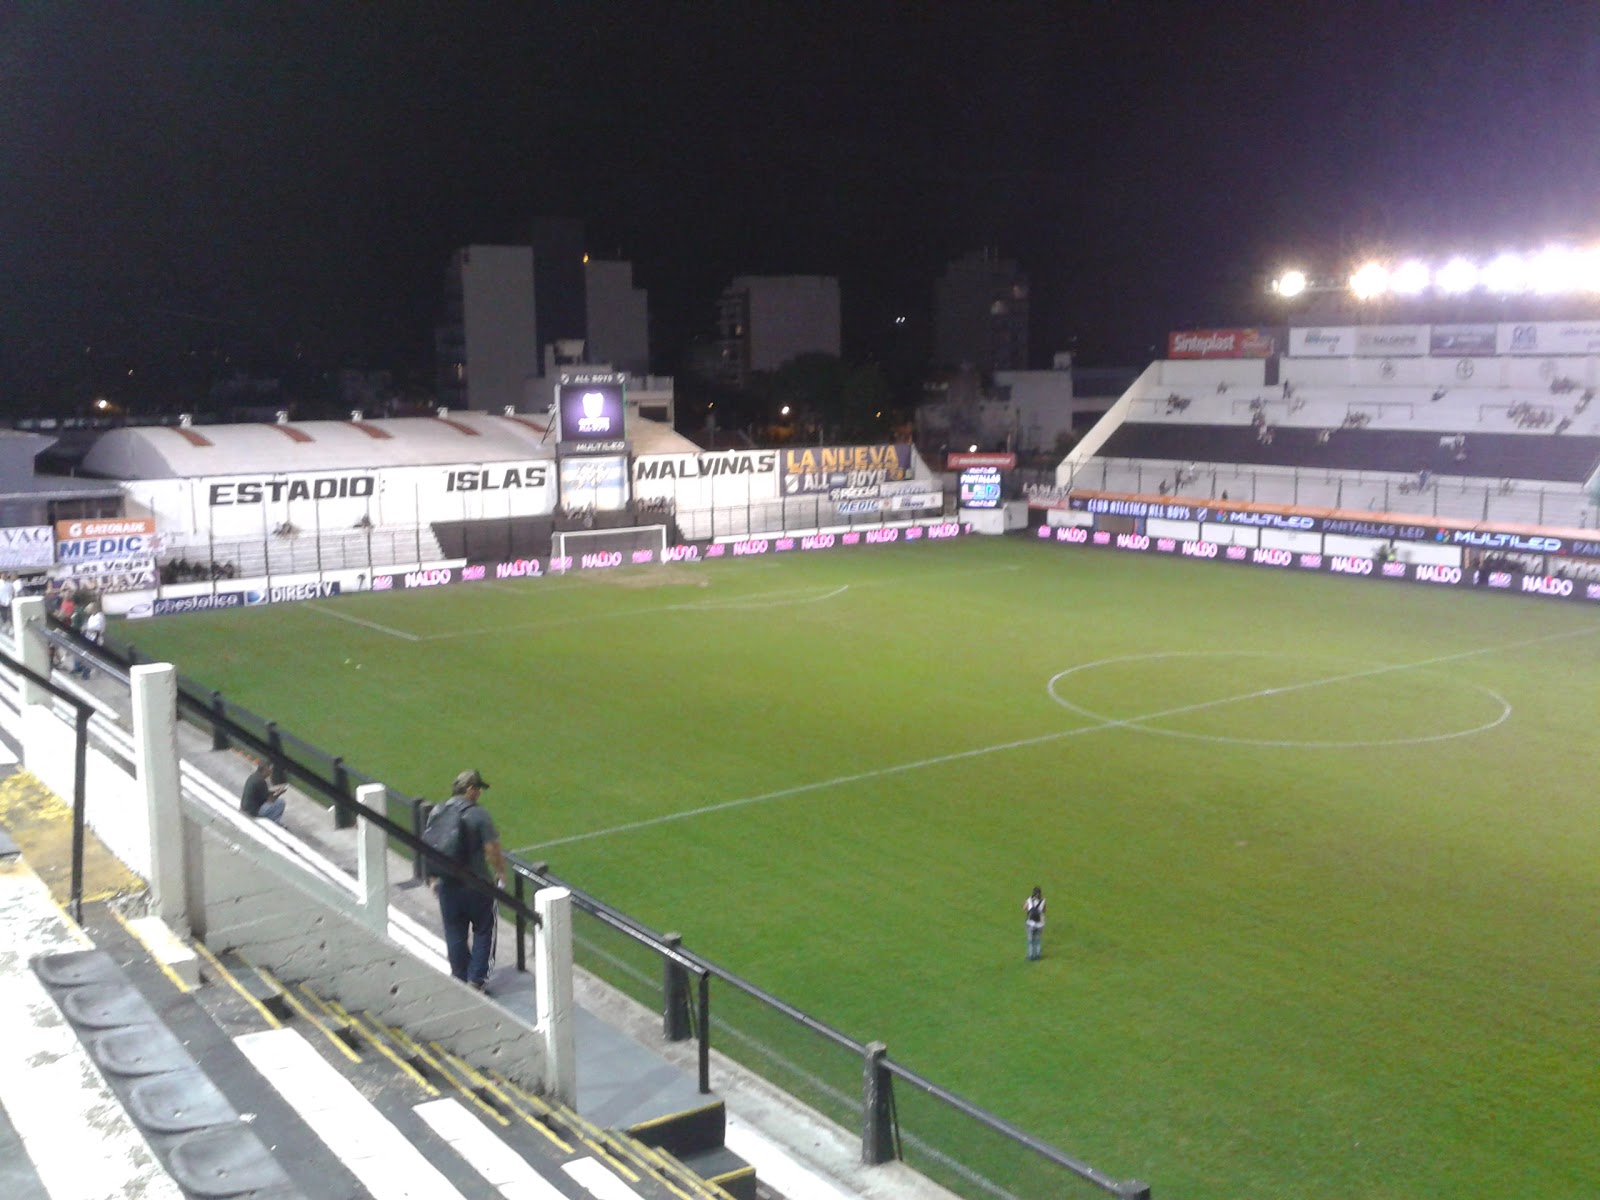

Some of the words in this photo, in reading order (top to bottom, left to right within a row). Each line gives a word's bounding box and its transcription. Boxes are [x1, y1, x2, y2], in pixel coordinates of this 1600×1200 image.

[1174, 333, 1235, 356] Sinteplast
[576, 443, 625, 452] MULTILED
[637, 455, 775, 481] MALVINAS
[787, 449, 819, 473] LA
[821, 445, 899, 472] NUEVA
[446, 467, 547, 492] ISLAS
[803, 472, 830, 491] ALL
[209, 477, 375, 507] ESTADIO
[961, 484, 1001, 500] LED
[1148, 504, 1164, 518] ALL
[1166, 506, 1190, 520] BOYS
[866, 527, 898, 543] NALDO
[928, 522, 959, 538] NALDO
[1057, 526, 1087, 543] NALDO
[1230, 512, 1315, 530] MULTILED
[1322, 520, 1395, 537] PANTALLAS
[1399, 526, 1425, 538] LED
[1454, 530, 1562, 551] MULTILED
[60, 537, 143, 559] MEDIC
[734, 540, 768, 555] NALDO
[801, 533, 835, 549] NALDO
[1117, 533, 1150, 550] NALDO
[1182, 541, 1218, 558] NALDO
[582, 552, 622, 568] NALDO
[1253, 548, 1292, 566] NALDO
[1331, 557, 1373, 575] NALDO
[72, 563, 99, 575] Las
[104, 558, 152, 575] Vegas
[497, 560, 539, 578] NALDO
[1416, 565, 1462, 584] NALDO
[405, 569, 451, 587] NALDO
[1522, 576, 1573, 596] NALDO
[270, 581, 334, 603] DIRECTV
